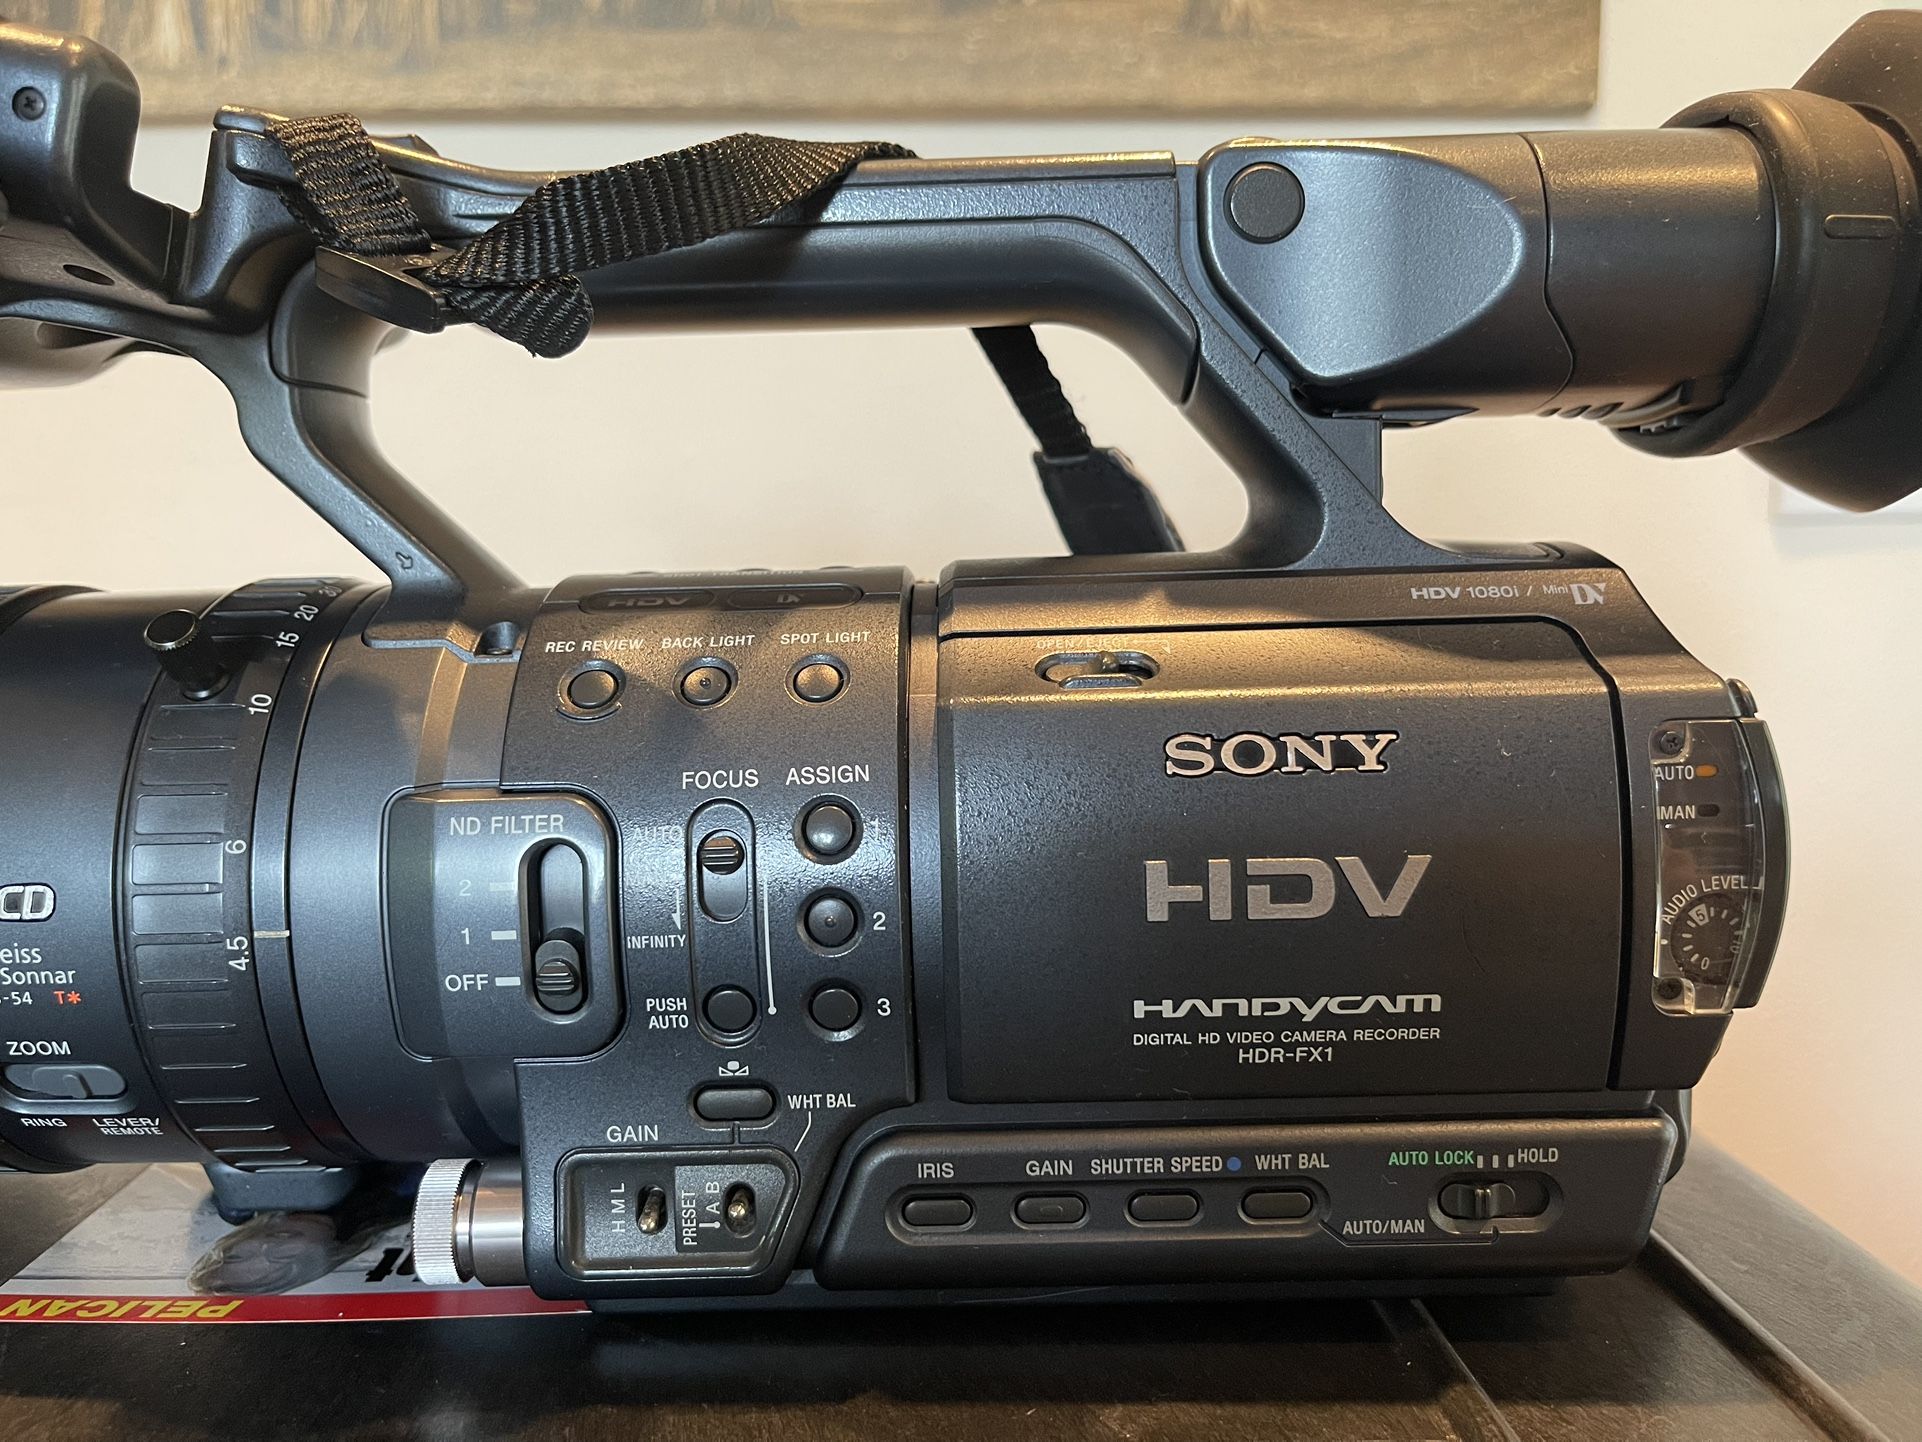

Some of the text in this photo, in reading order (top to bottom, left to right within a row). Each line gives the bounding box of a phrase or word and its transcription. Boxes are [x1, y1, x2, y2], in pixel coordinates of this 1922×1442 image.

[1410, 586, 1461, 600] HDV
[1466, 585, 1519, 599] 1080i
[1542, 584, 1569, 595] Mini
[1569, 582, 1607, 605] DV
[294, 604, 319, 622] 20
[275, 631, 300, 648] 15
[544, 638, 644, 653] REC REVIEW
[661, 634, 756, 649] BACK LIGHT
[779, 631, 872, 645] SPOT LIGHT
[248, 693, 273, 716] 10
[1165, 732, 1399, 776] SONY
[681, 770, 759, 790] FOCUS
[785, 764, 871, 786] ASSIGN
[1655, 765, 1695, 781] AUTO
[450, 814, 564, 836] ND FILTER
[225, 838, 247, 854] 6
[458, 879, 472, 897] 2
[1144, 854, 1433, 922] HDV
[1662, 875, 1749, 925] AUDIO LEVEL
[872, 911, 887, 931] 2
[1695, 910, 1706, 923] 5
[460, 927, 471, 945] 1
[627, 934, 687, 949] INFINITY
[226, 936, 250, 972] 4.5
[1700, 957, 1710, 970] 0
[445, 973, 489, 992] OFF
[0, 991, 35, 1006] -54
[646, 998, 688, 1014] PUSH
[876, 998, 891, 1017] 3
[648, 1014, 689, 1030] AUTO
[1132, 1027, 1441, 1046] DIGITAL HD VIDEO CAMERA RECORDER
[6, 1041, 71, 1056] ZOOM
[1238, 1046, 1333, 1064] HDR-FX1
[787, 1092, 857, 1110] WHT BAL
[20, 1117, 68, 1128] RING
[92, 1117, 160, 1127] LEVER/
[100, 1126, 164, 1136] REMOTE
[606, 1124, 659, 1143] GAIN
[1255, 1152, 1330, 1171] WHT BAL
[1388, 1150, 1475, 1166] AUTO LOCK
[1517, 1147, 1559, 1164] HOLD
[917, 1162, 955, 1179] IRIS
[1025, 1159, 1073, 1177] GAIN
[1090, 1156, 1223, 1175] SHUTTER SPEED
[706, 1181, 721, 1214] A B
[610, 1182, 626, 1233] H M L
[682, 1189, 698, 1246] PRESET
[1342, 1218, 1426, 1235] AUTO/MAN
[0, 1298, 245, 1319] PELICAN
